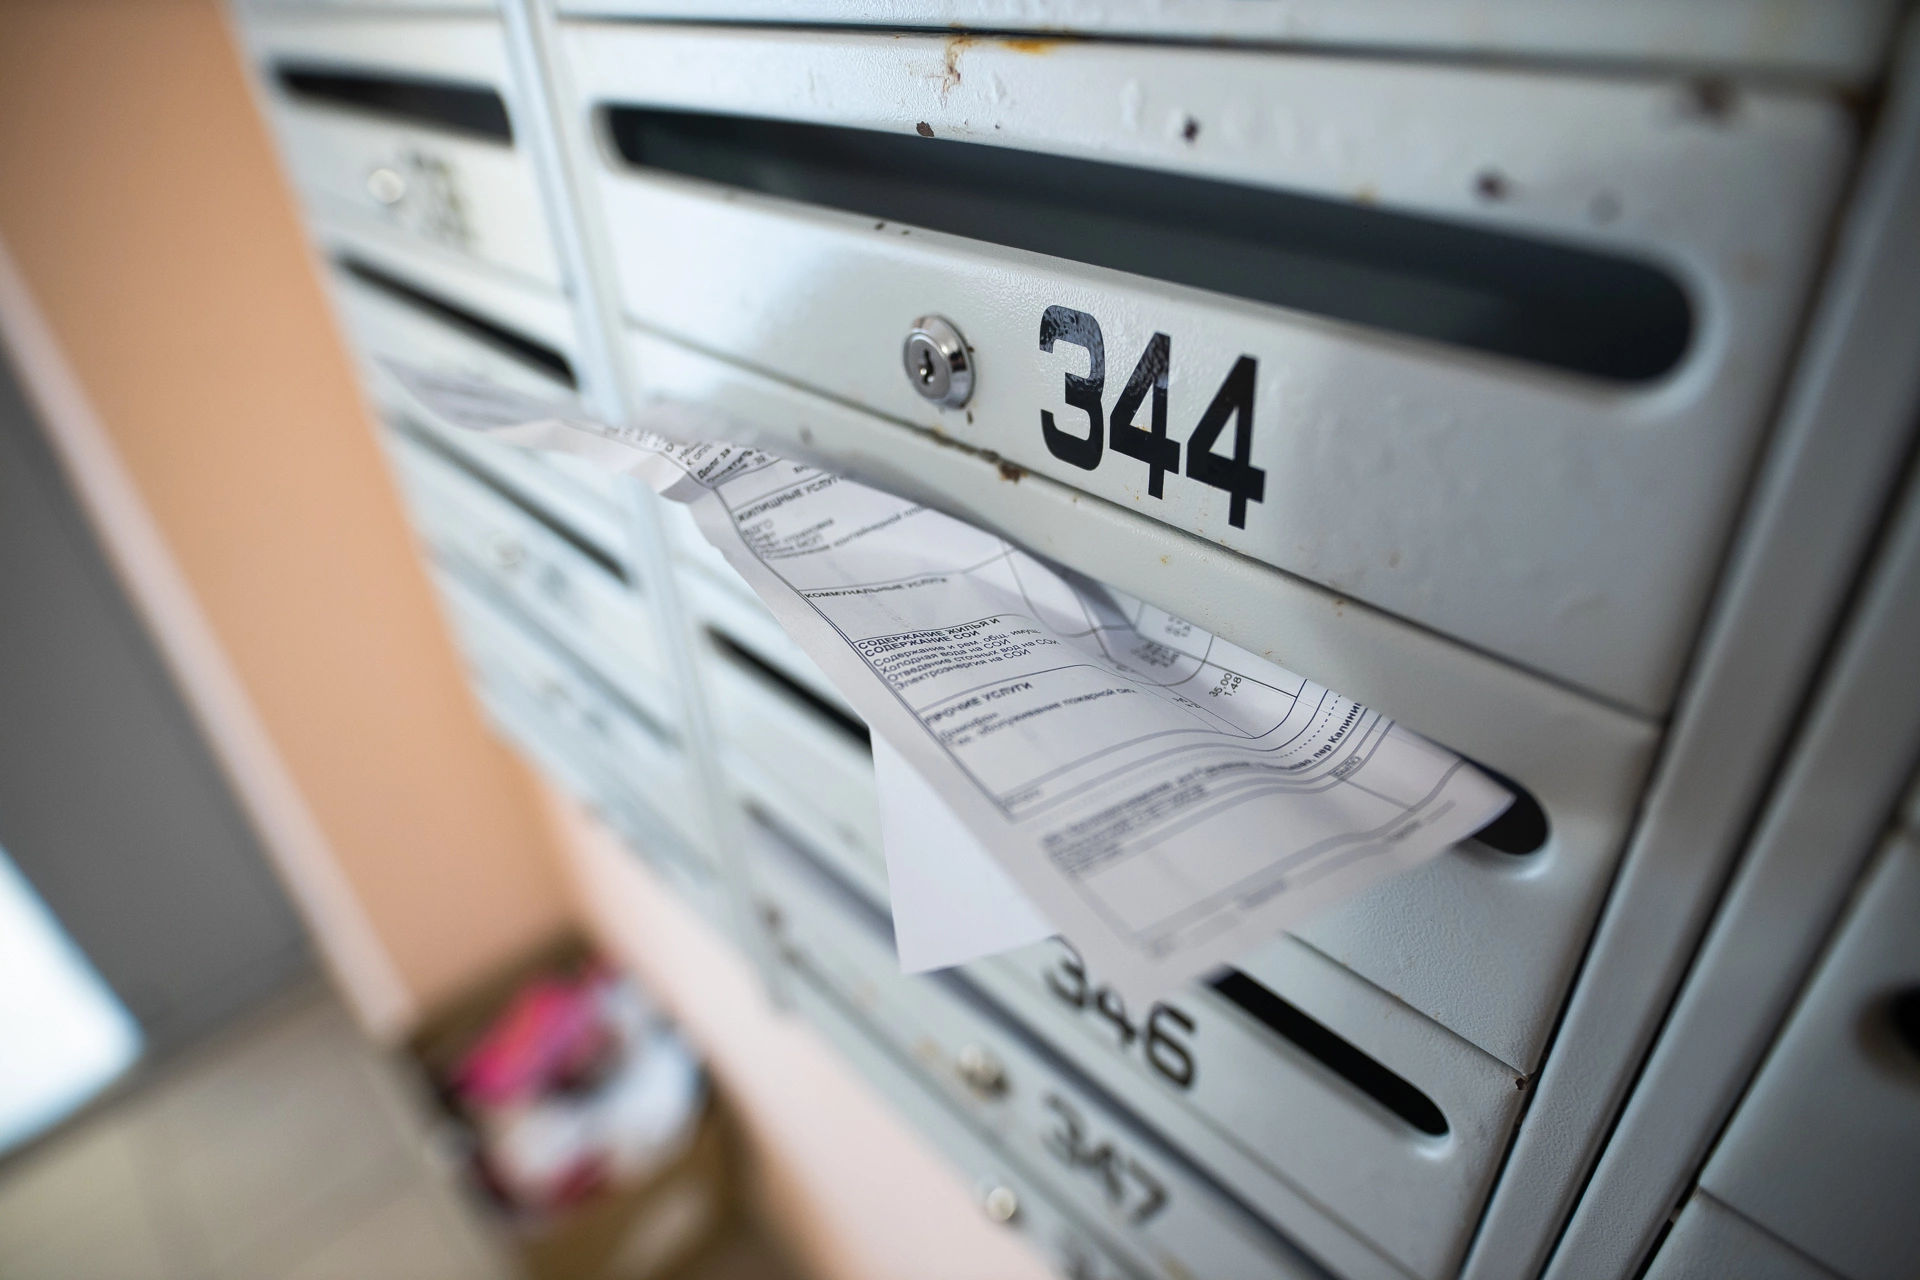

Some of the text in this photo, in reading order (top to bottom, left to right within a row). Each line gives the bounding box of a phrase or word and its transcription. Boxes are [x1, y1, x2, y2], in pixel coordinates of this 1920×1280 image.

[1039, 304, 1265, 530] 344
[738, 475, 845, 522] ЖИЛИЩНЫЕ УСЛУГ
[804, 583, 904, 599] КОММУНАЛЬНЫЕ
[858, 630, 945, 649] СОДЕРЖАНИЕ
[945, 620, 989, 635] ЖИЛЬЯ
[865, 630, 980, 657] СОДЕРЖАНИЕ СОИ
[873, 645, 945, 667] Содержание
[957, 640, 982, 649] рем.
[983, 634, 1010, 642] общ.
[880, 652, 939, 674] Холодная
[940, 649, 967, 657] вода
[983, 638, 1011, 649] СОИ
[887, 658, 952, 682] Отведение
[953, 649, 1000, 662] сточных
[1000, 644, 1020, 653] вод
[1021, 640, 1036, 648] на
[894, 659, 987, 690] Электроэнергия
[1003, 648, 1031, 659] СОИ
[1209, 672, 1232, 697] 35,00
[1224, 676, 1242, 697] 1,48
[924, 681, 1034, 726] ПРОЧИЕ УСЛУГИ
[1313, 743, 1333, 758] пер
[1043, 931, 1196, 1090] 346
[1038, 1090, 1169, 1226] 347
